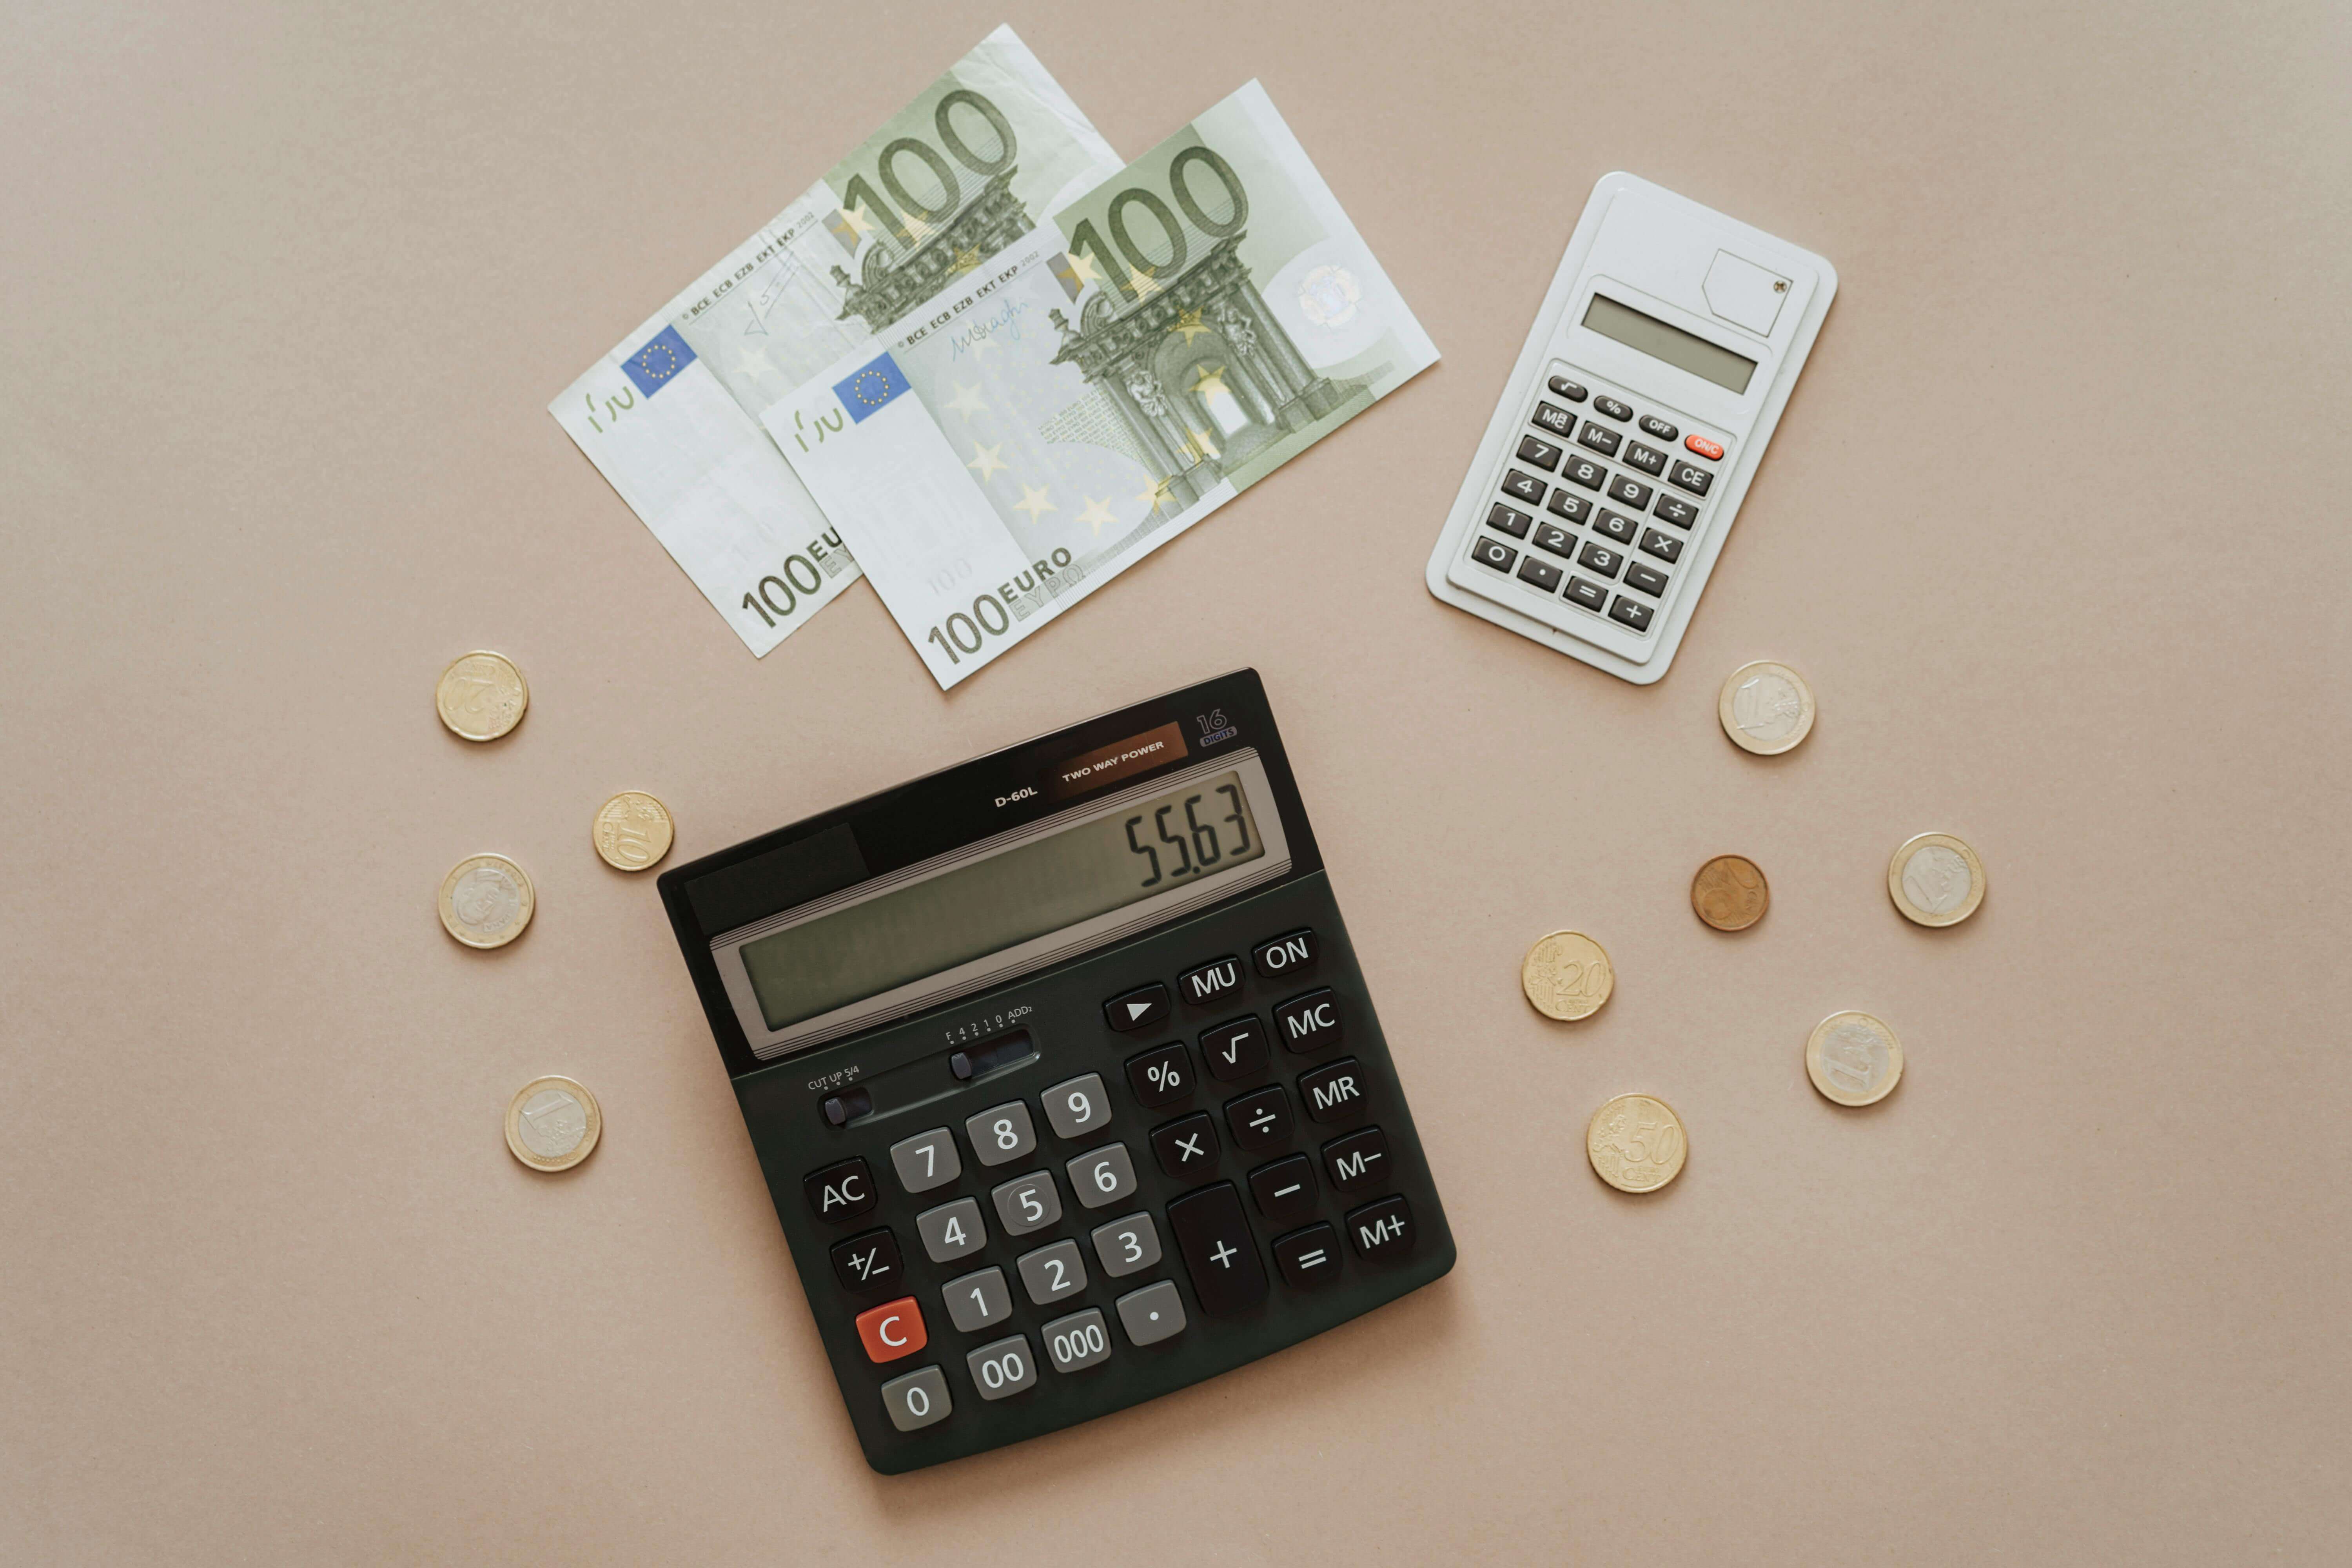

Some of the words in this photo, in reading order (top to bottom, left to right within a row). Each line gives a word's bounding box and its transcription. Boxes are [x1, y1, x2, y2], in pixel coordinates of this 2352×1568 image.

[843, 89, 1017, 251] 100
[1069, 146, 1249, 303] 100
[691, 298, 711, 316] BCE
[712, 279, 733, 298] ECB
[734, 262, 754, 281] EZB
[756, 244, 776, 263] EKT
[776, 228, 795, 247] EKP
[796, 211, 814, 229] 2002
[907, 327, 928, 345] BCE
[930, 311, 951, 329] ECB
[953, 296, 974, 314] EZB
[976, 280, 997, 298] EKT
[998, 265, 1018, 283] EKP
[1020, 250, 1040, 267] 2002
[1649, 419, 1671, 434] OFF
[1534, 444, 1549, 458] 7
[1633, 448, 1657, 465] M+
[1695, 438, 1719, 455] ON/C
[1517, 480, 1533, 494] 4
[1577, 463, 1594, 480] 8
[1681, 468, 1705, 486] CE
[1563, 497, 1579, 513] 5
[1623, 483, 1640, 499] 9
[1506, 512, 1515, 526] 1
[1609, 517, 1626, 533] 6
[1488, 546, 1506, 562] 0
[1547, 531, 1564, 548] 2
[1593, 550, 1611, 567] 3
[742, 554, 821, 628] 100
[928, 594, 1009, 665] 100
[997, 547, 1072, 604] EURO
[1196, 708, 1227, 735] 16
[1203, 727, 1235, 746] DIGITS
[1062, 766, 1091, 783] TWO
[1093, 757, 1119, 772] WAY
[1121, 740, 1165, 762] POWER
[994, 786, 1038, 808] D-60L
[617, 822, 652, 863] 10
[1125, 784, 1251, 888] 55.63
[1265, 937, 1309, 969] ON
[1191, 963, 1236, 998] MU
[1556, 960, 1606, 997] 20
[946, 1031, 952, 1041] F
[959, 1027, 965, 1036] 4
[971, 1023, 978, 1032] 2
[984, 1019, 989, 1028] 1
[995, 1014, 1003, 1024] 0
[1287, 1003, 1335, 1039] MC
[808, 1076, 828, 1091] CUT
[829, 1071, 842, 1083] UP
[844, 1065, 860, 1077] 5/4
[1312, 1075, 1360, 1110] MR
[1067, 1091, 1092, 1123] 9
[992, 1118, 1019, 1151] 8
[1624, 1121, 1680, 1165] 50
[915, 1144, 935, 1178] 7
[1094, 1161, 1118, 1192] 6
[822, 1174, 866, 1213] AC
[1018, 1188, 1045, 1222] 5
[943, 1216, 967, 1246] 4
[1118, 1231, 1143, 1263] 3
[1359, 1214, 1405, 1250] M+
[1044, 1259, 1071, 1292] 2
[969, 1287, 989, 1318] 1
[879, 1316, 908, 1347] C
[1053, 1324, 1105, 1364] 000
[981, 1352, 1024, 1389] 00
[906, 1387, 930, 1417] 0
